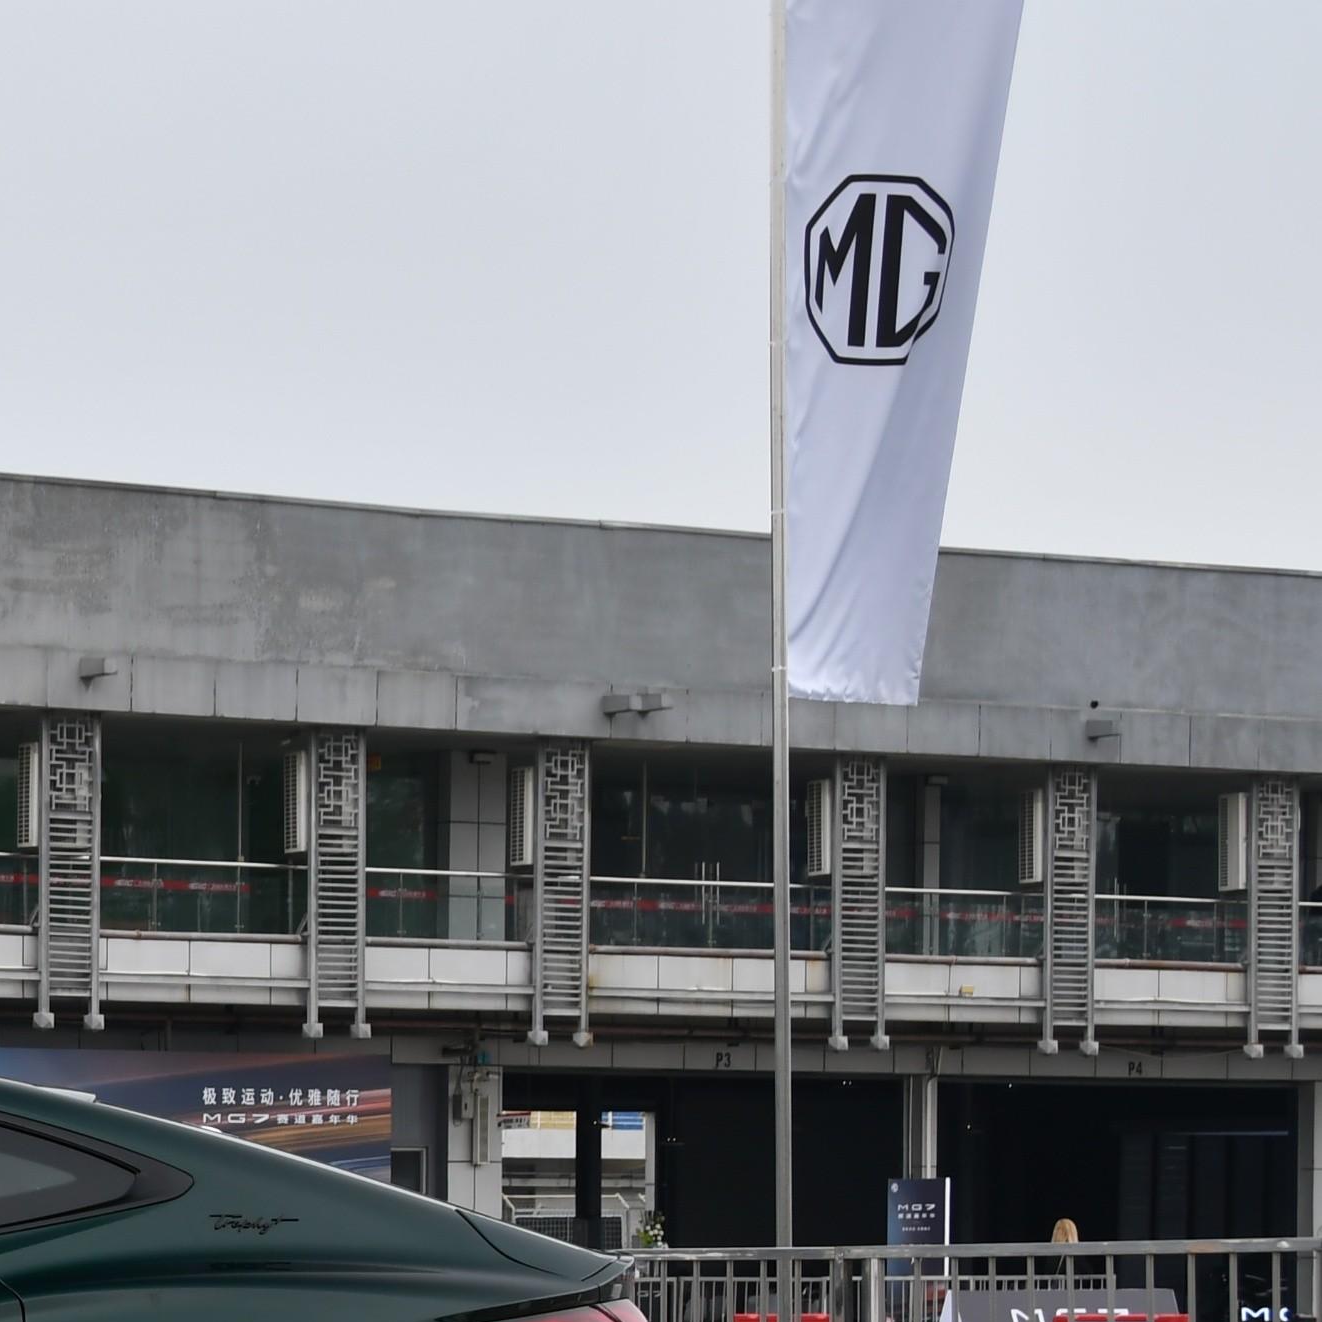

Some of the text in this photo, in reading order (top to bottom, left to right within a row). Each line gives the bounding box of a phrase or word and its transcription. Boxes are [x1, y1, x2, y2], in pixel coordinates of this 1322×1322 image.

[815, 194, 947, 348] MG
[715, 1052, 732, 1068] P3
[1128, 1061, 1143, 1076] P4
[203, 1113, 270, 1124] MG7
